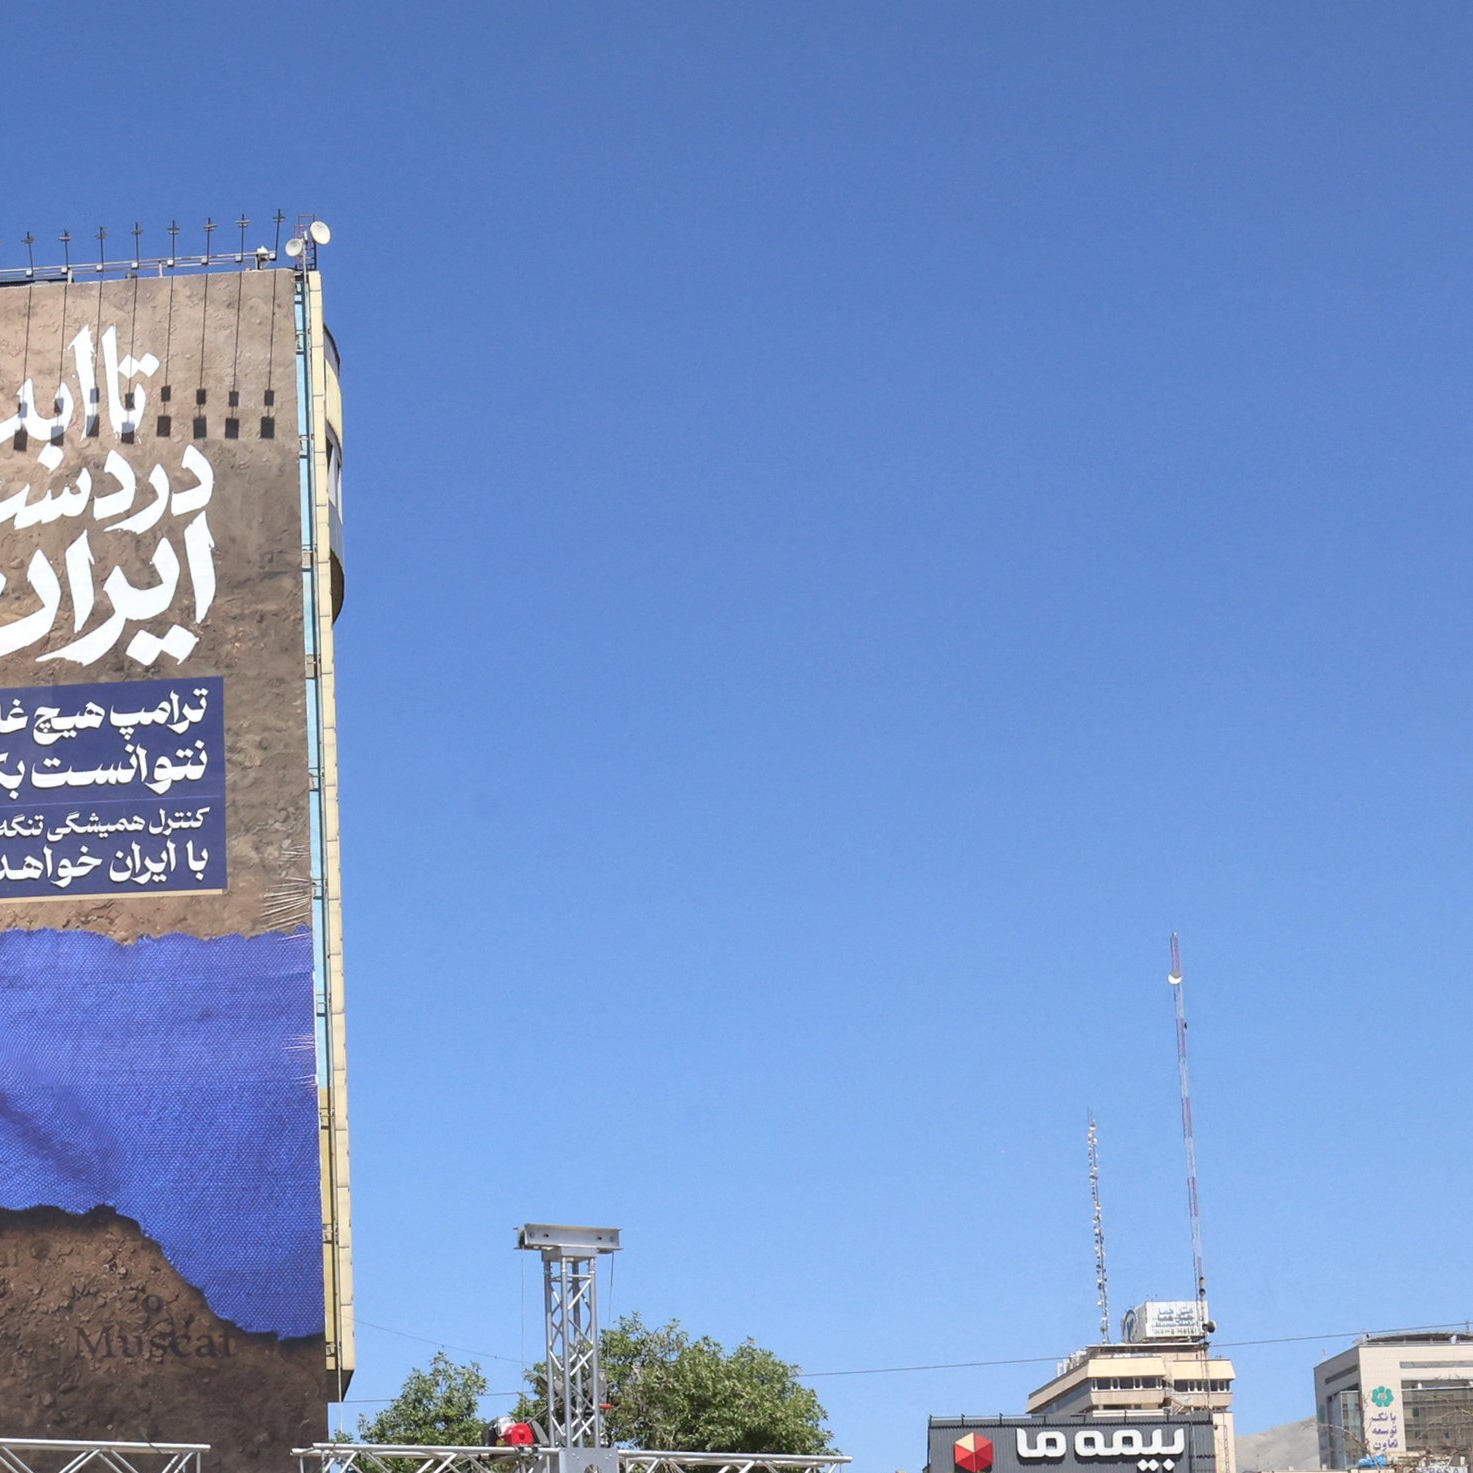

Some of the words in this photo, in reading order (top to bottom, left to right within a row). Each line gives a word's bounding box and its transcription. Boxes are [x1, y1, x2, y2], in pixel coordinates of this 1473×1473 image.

[101, 323, 160, 437] تا
[104, 445, 214, 534] در
[33, 702, 105, 745] هیچ
[110, 687, 208, 740] ترامپ
[31, 740, 208, 795] نتوانست
[47, 811, 146, 842] همیشگی
[148, 807, 210, 835] کنترل
[109, 839, 176, 884] ایران
[186, 840, 209, 881] با
[73, 1325, 238, 1361] Muscat
[1372, 1412, 1396, 1424] بانک
[1372, 1426, 1397, 1438] توسعه
[1016, 1428, 1067, 1458] ما
[1075, 1428, 1186, 1472] بیمه
[1373, 1439, 1399, 1451] تعاون
